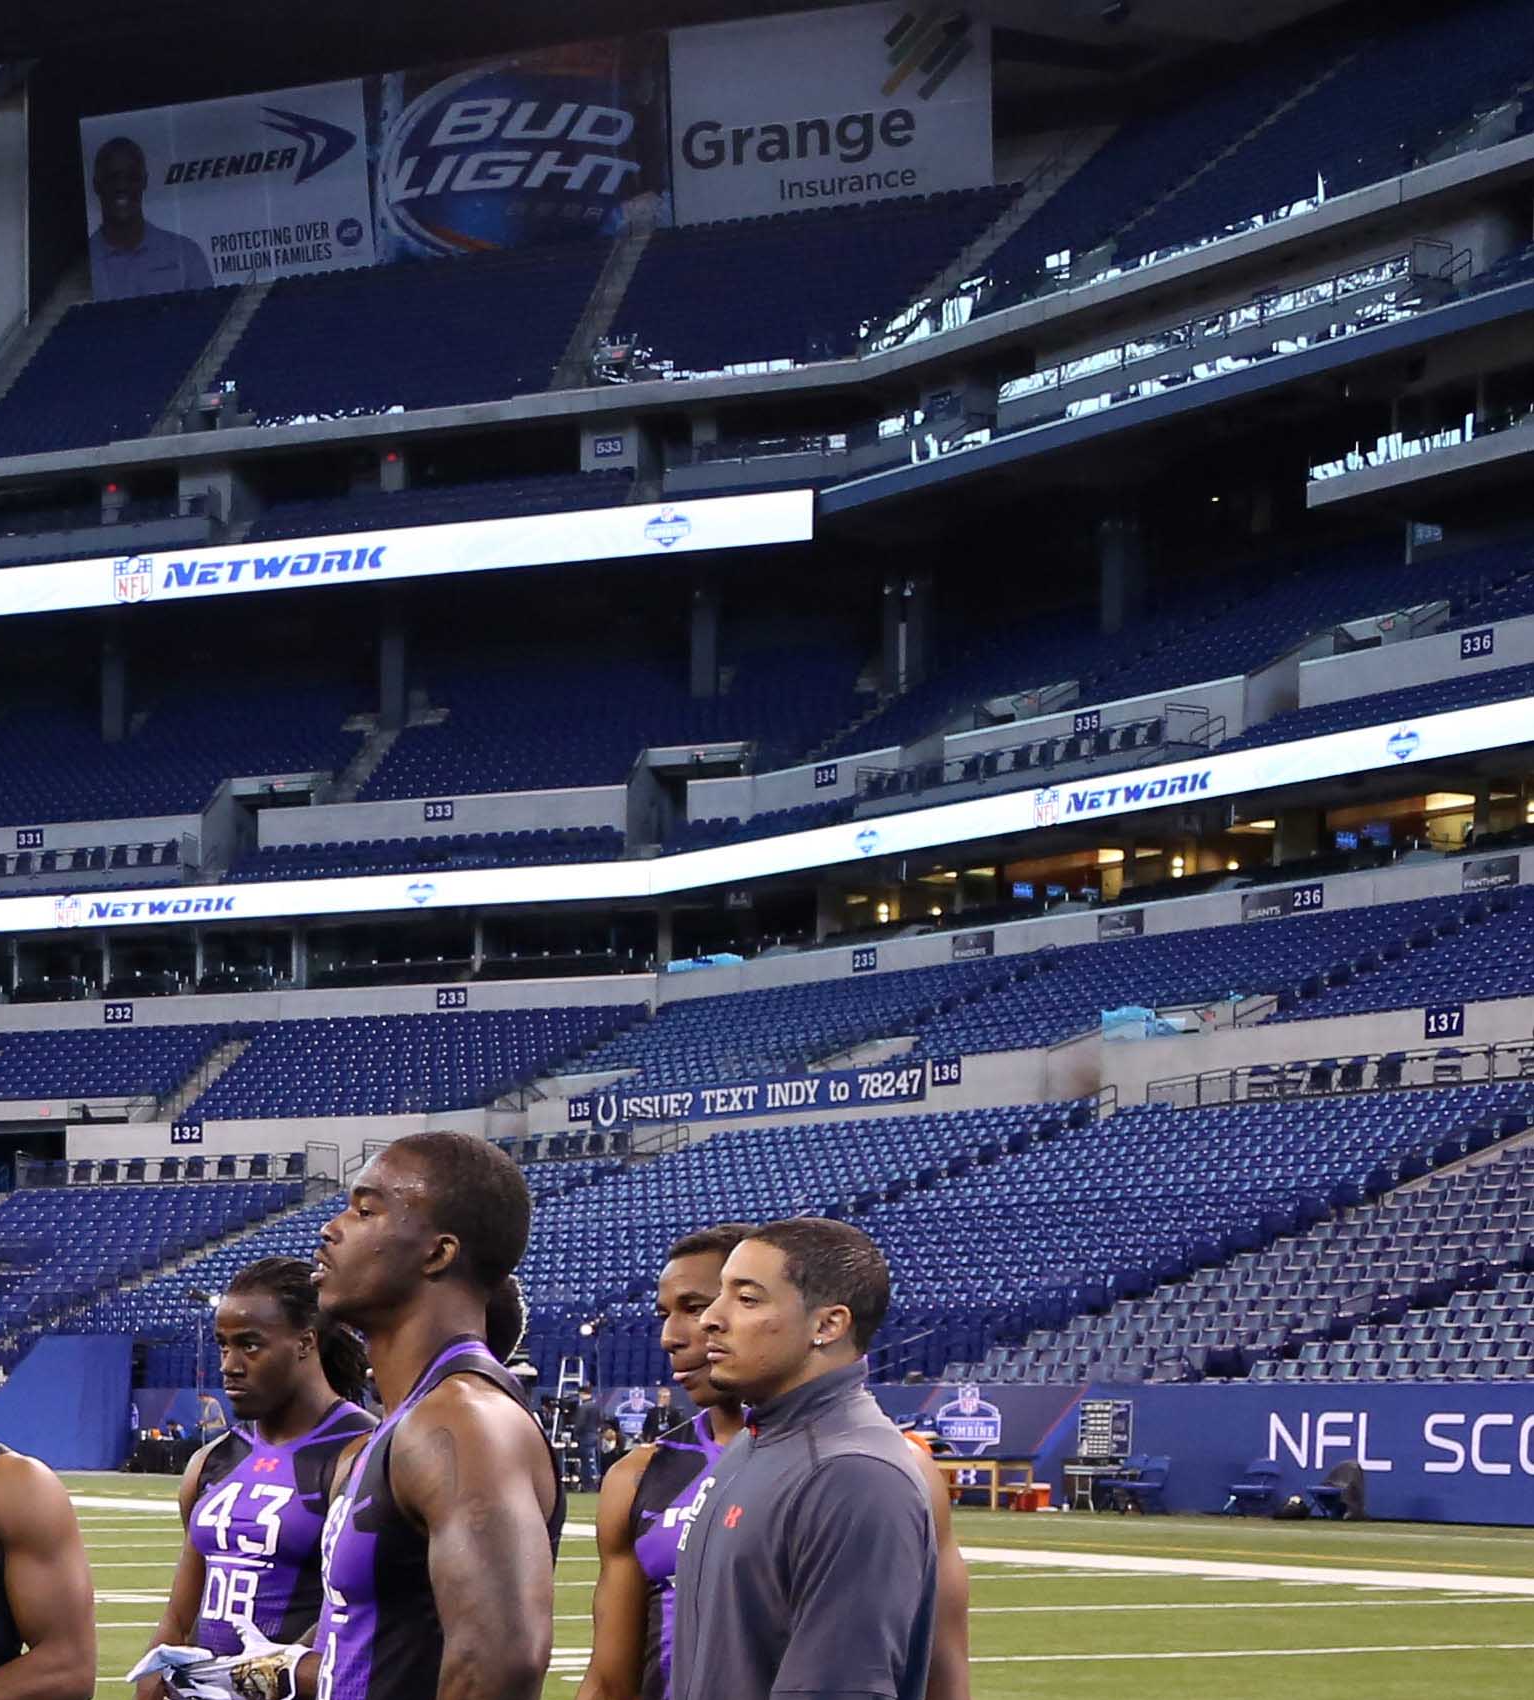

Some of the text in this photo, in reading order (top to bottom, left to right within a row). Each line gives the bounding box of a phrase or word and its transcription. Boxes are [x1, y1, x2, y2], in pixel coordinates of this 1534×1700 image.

[429, 99, 633, 146] BUD
[683, 107, 916, 170] Grange
[164, 147, 297, 185] DEFENDER
[388, 151, 641, 204] LIGHT
[780, 168, 917, 200] Insurance
[211, 221, 330, 252] PROTECTING OVER
[220, 252, 272, 273] MILLION
[275, 243, 332, 269] FAMILIES
[595, 440, 622, 454] 533
[118, 546, 386, 598] NFL NETWORK
[1463, 634, 1491, 654] 336
[1075, 715, 1098, 732] 335
[816, 769, 836, 784] 334
[1066, 770, 1212, 814] NETWORK
[426, 803, 453, 819] 333
[17, 831, 43, 847] 331
[88, 896, 235, 919] NETWORK
[1294, 888, 1321, 907] 236
[853, 953, 876, 969] 235
[438, 991, 466, 1006] 233
[106, 1006, 131, 1020] 232
[1428, 1012, 1460, 1033] 137
[933, 1064, 959, 1082] 136
[622, 1069, 923, 1121] ISSUE? TEXT INDY to 78247
[569, 1103, 590, 1119] 135
[174, 1126, 201, 1140] 132
[942, 1425, 996, 1438] COMBINE
[1269, 1411, 1393, 1472] NFL
[196, 1482, 295, 1556] 43
[204, 1566, 259, 1621] DB
